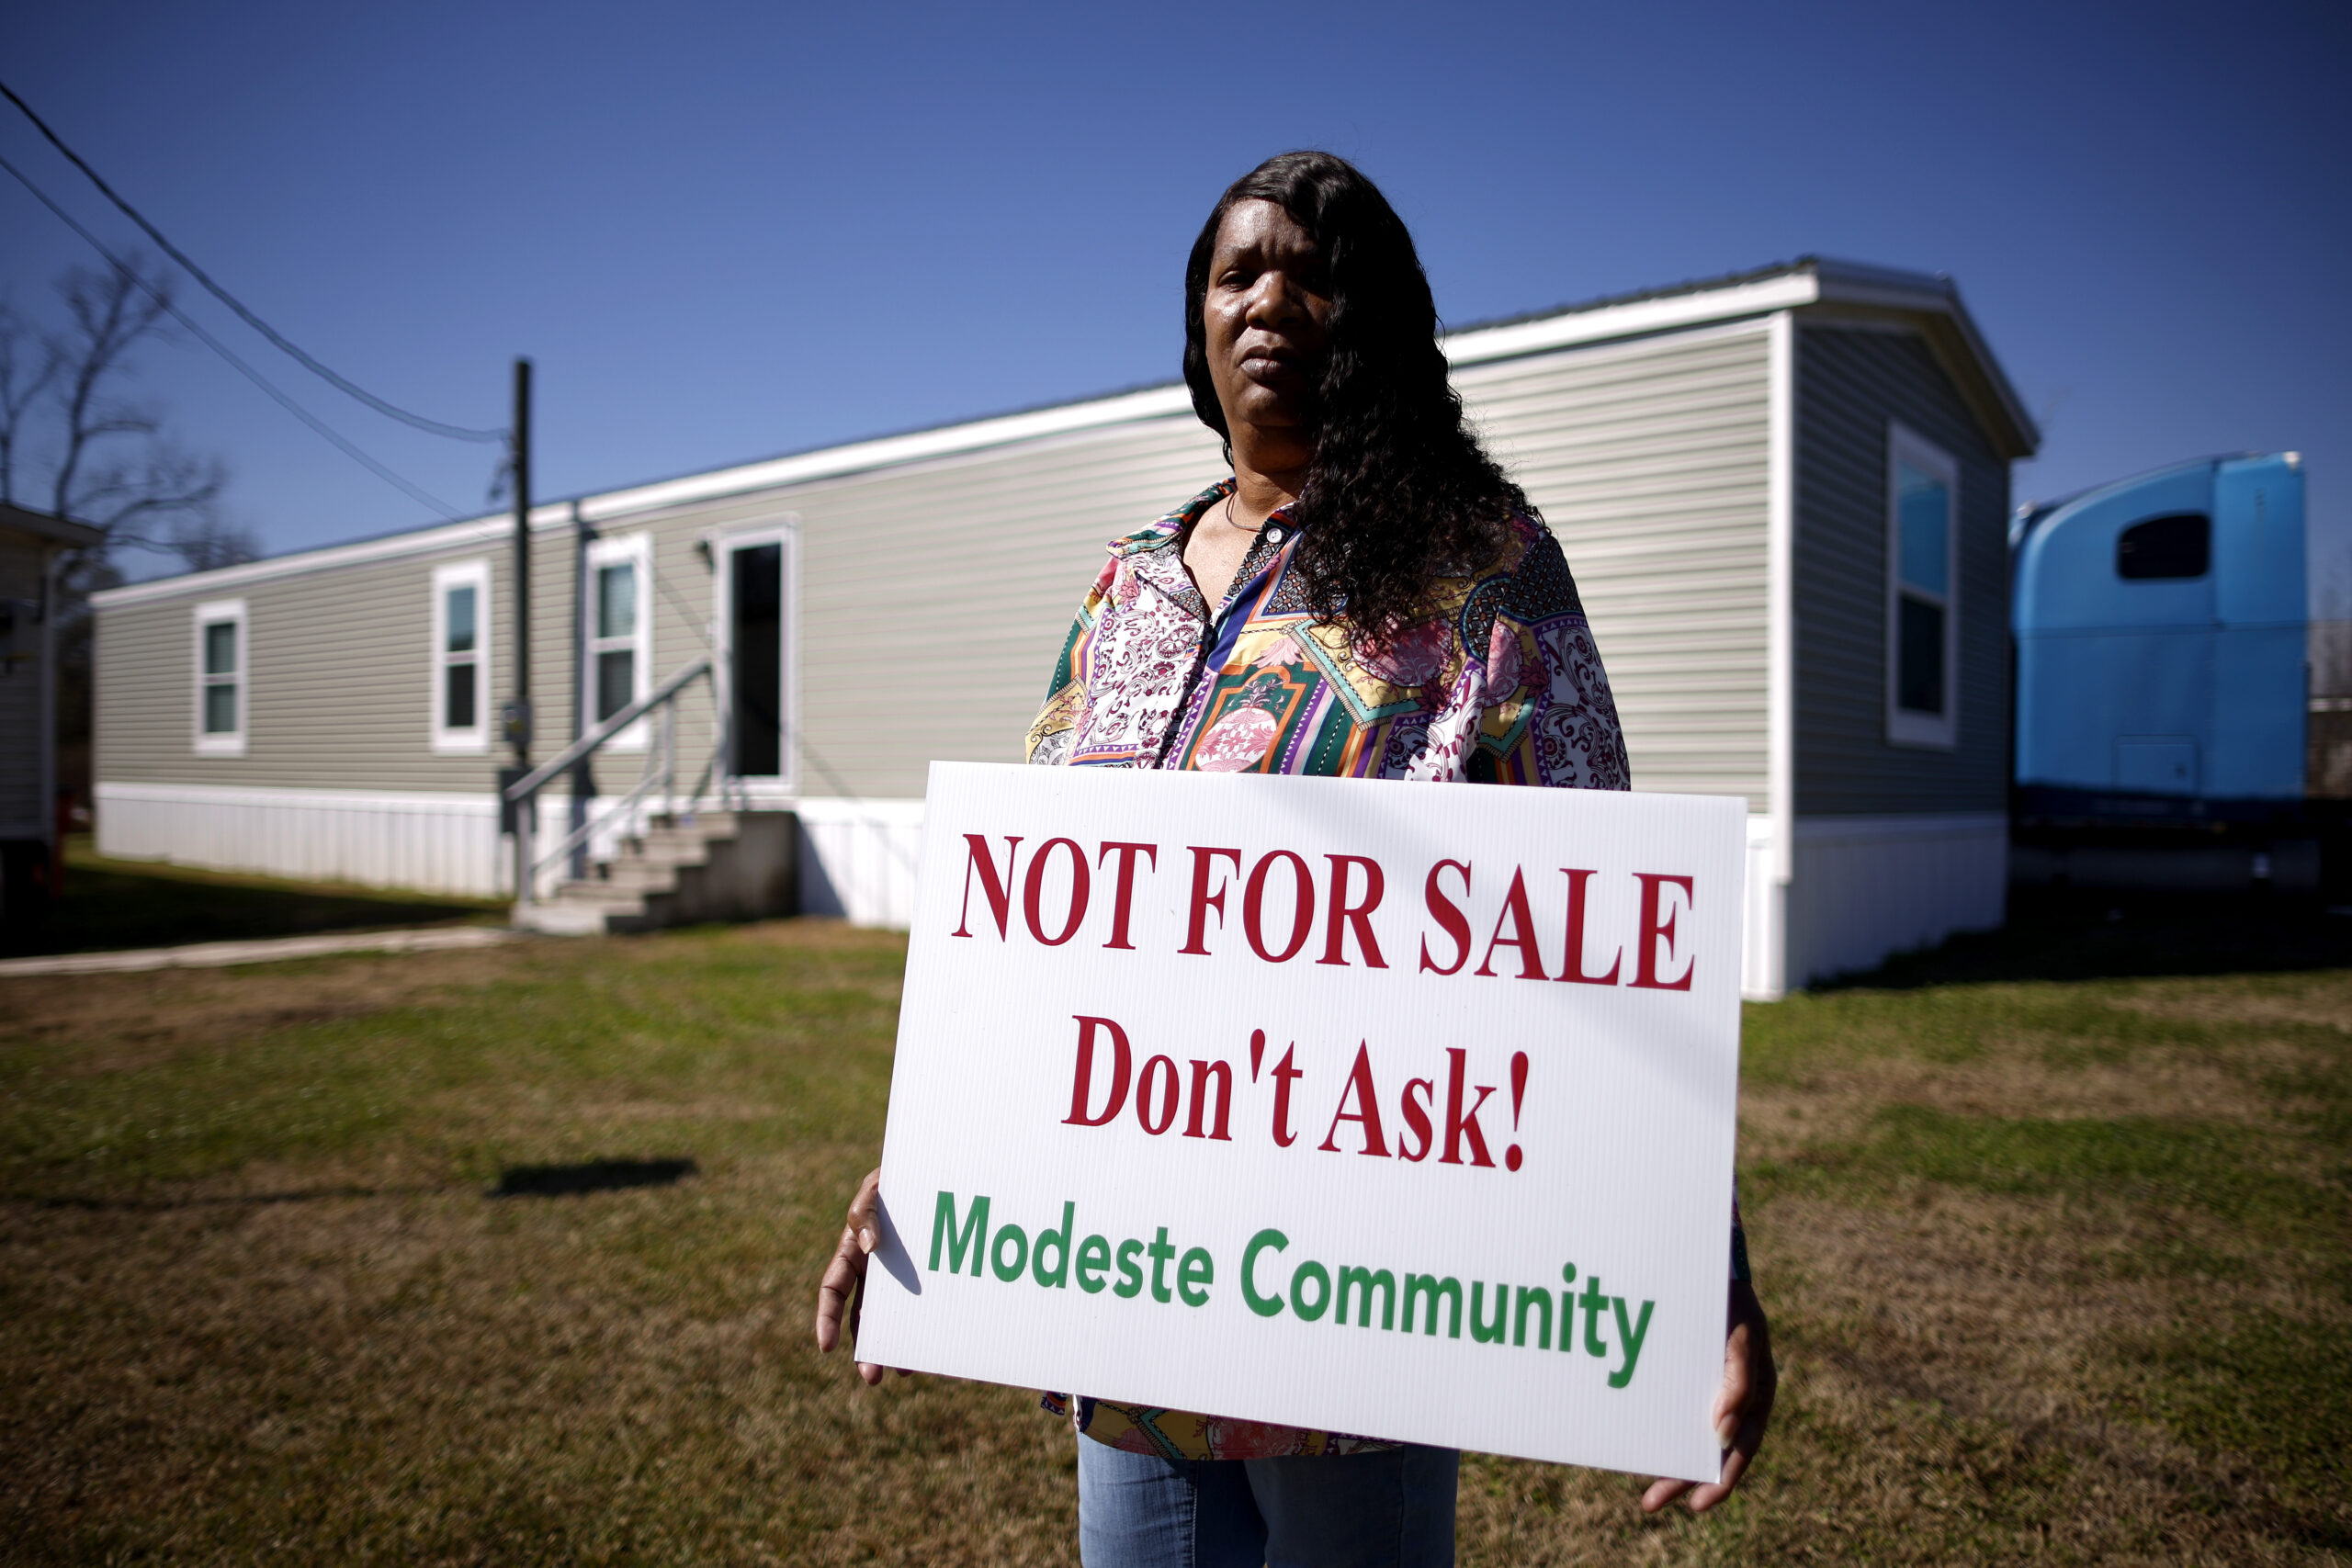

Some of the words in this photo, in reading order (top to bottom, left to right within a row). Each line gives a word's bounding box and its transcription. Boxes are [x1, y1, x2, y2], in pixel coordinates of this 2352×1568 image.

[951, 833, 1158, 951] NOT
[1178, 846, 1390, 969] FOR
[1419, 859, 1696, 992] SALE
[1061, 1015, 1305, 1148] Don't
[1317, 1038, 1530, 1172] Ask!
[929, 1191, 1215, 1308] Modeste
[1240, 1228, 1655, 1389] Community
